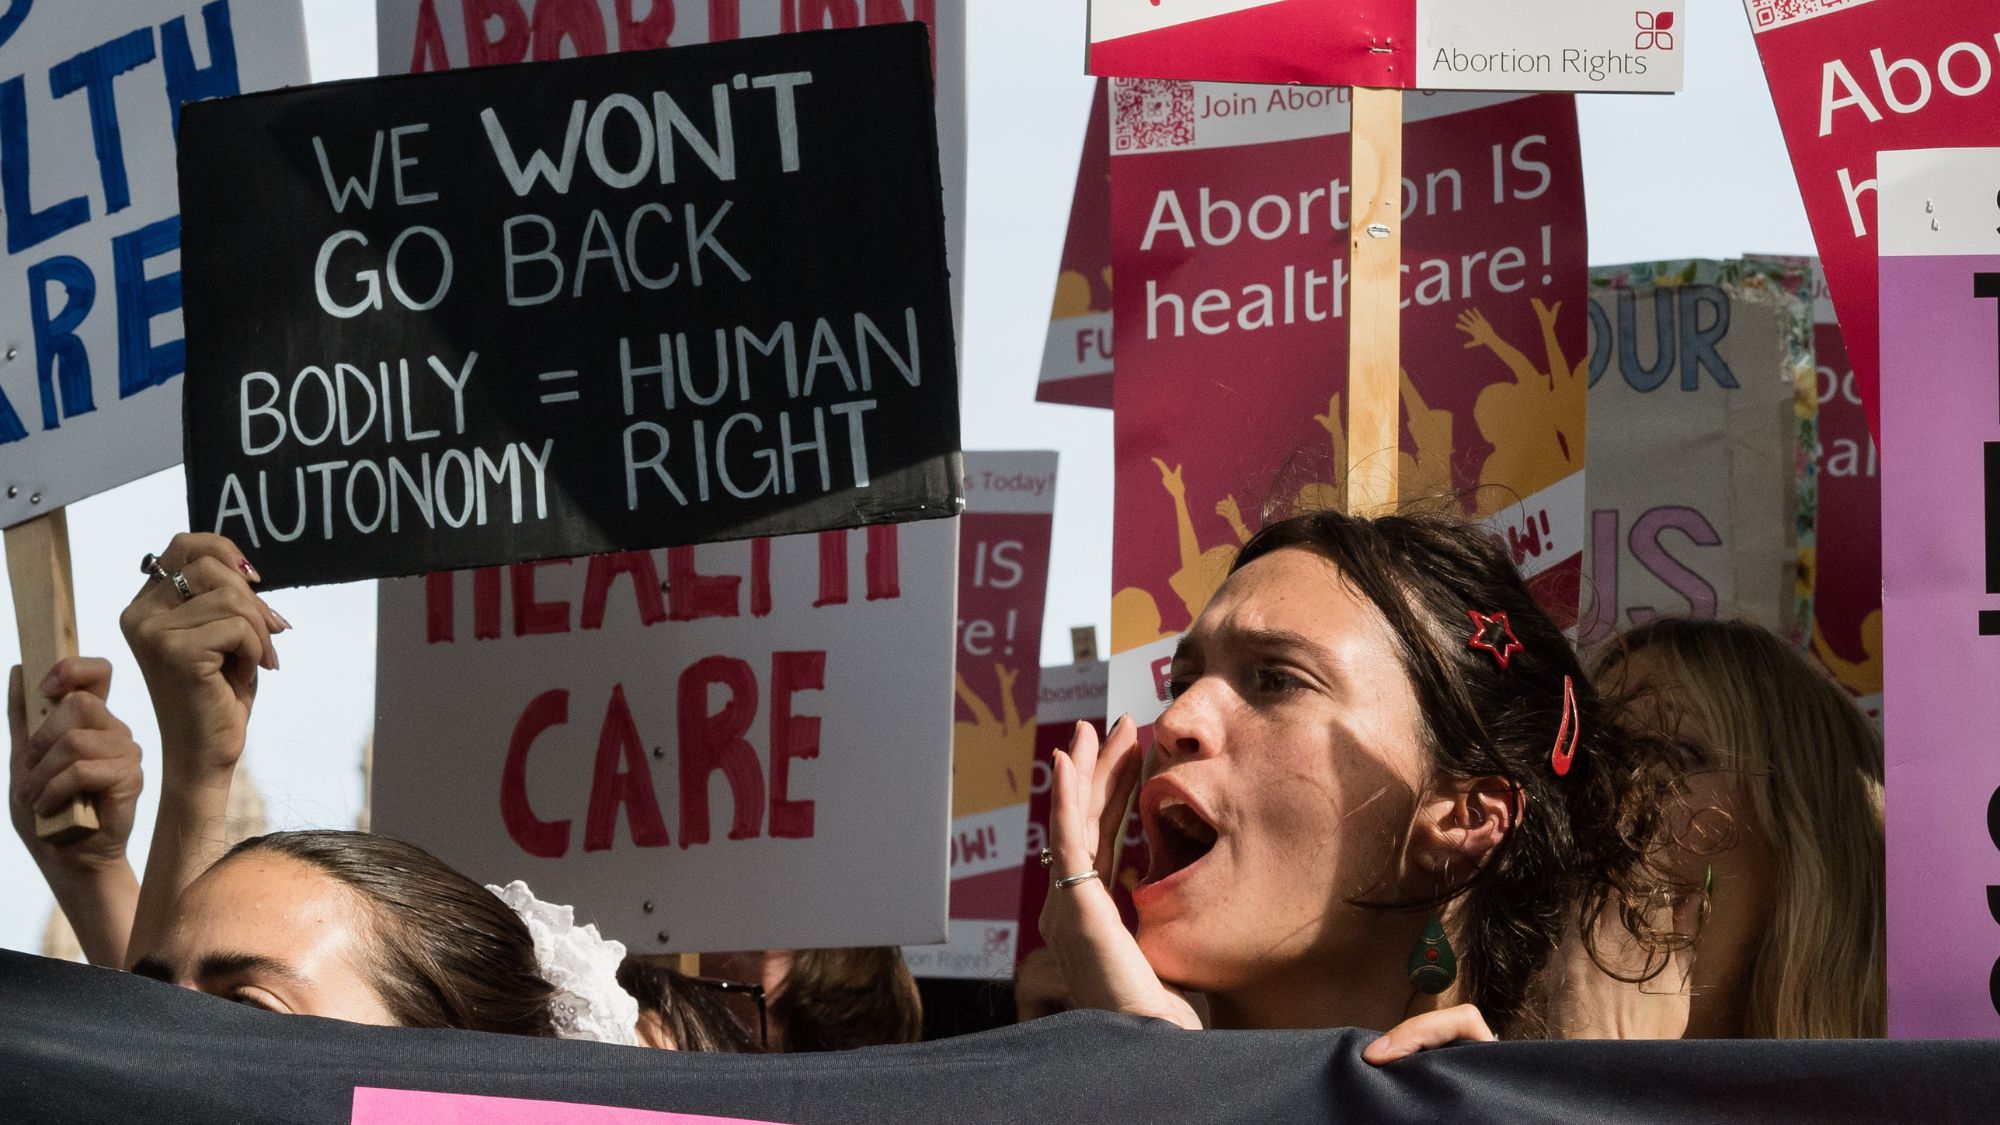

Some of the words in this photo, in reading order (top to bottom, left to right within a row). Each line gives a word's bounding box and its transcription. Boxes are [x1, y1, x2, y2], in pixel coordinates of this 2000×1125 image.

[1200, 91, 1257, 120] Join
[1432, 47, 1551, 73] Abortion
[1562, 48, 1648, 82] Rights
[1818, 33, 2000, 137] Abo
[312, 122, 439, 213] WE
[480, 70, 813, 197] WON'T
[1139, 167, 1463, 251] Abortn
[1492, 134, 1552, 204] IS
[314, 225, 454, 318] GO
[502, 199, 752, 306] BACK
[1145, 223, 1553, 341] healthare!
[240, 350, 479, 456] BODILY
[619, 306, 922, 416] HUMAN
[213, 437, 554, 548] AUTONOMY
[622, 398, 878, 511] RIGHT
[972, 538, 1025, 590] IS
[500, 650, 827, 859] CARE
